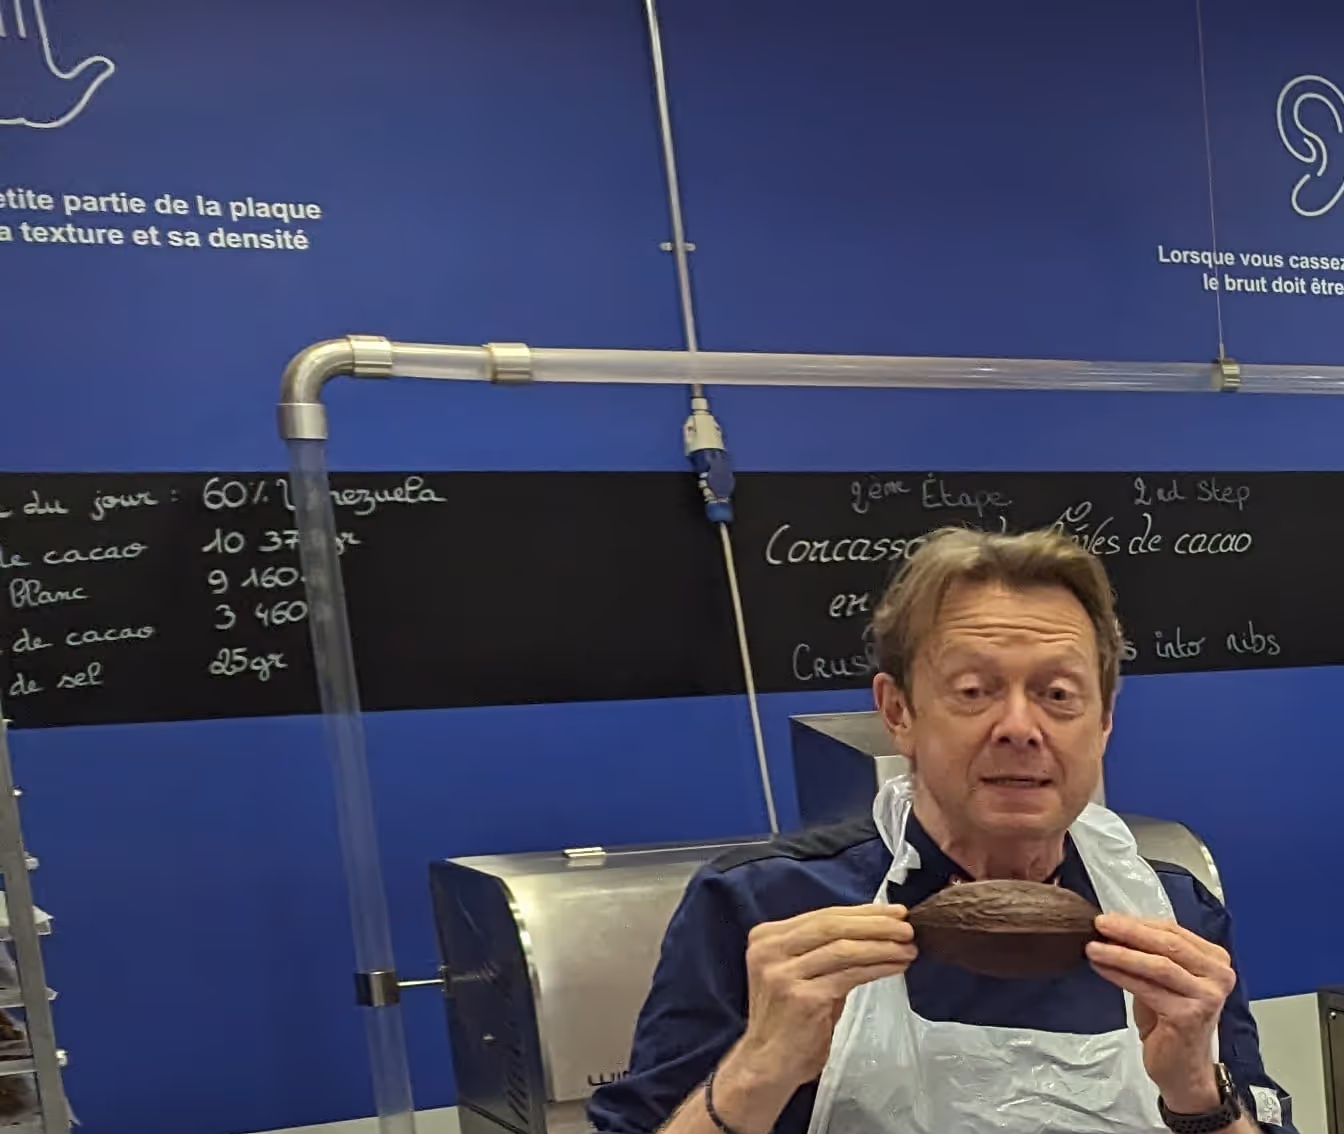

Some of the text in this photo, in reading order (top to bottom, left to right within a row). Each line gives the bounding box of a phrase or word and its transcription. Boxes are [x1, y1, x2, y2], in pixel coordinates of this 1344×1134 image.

[64, 192, 146, 215] partie
[155, 194, 189, 215] de
[197, 195, 222, 216] la
[229, 197, 322, 223] plaque
[20, 222, 124, 245] texture
[132, 226, 161, 245] et
[168, 230, 200, 247] sa
[209, 227, 309, 250] densité
[1158, 245, 1235, 269] Lorsque
[1240, 253, 1284, 268] vous
[1203, 273, 1219, 290] le
[1225, 274, 1267, 293] bruit
[1272, 277, 1306, 294] doit
[1311, 278, 1344, 296] être
[24, 490, 68, 515] du
[90, 490, 158, 521] jour
[43, 542, 148, 564] cacao
[202, 528, 245, 553] 10
[1128, 513, 1162, 555] de
[1174, 532, 1253, 554] cacao
[12, 628, 53, 652] de
[66, 626, 153, 646] cacao
[10, 673, 44, 695] de
